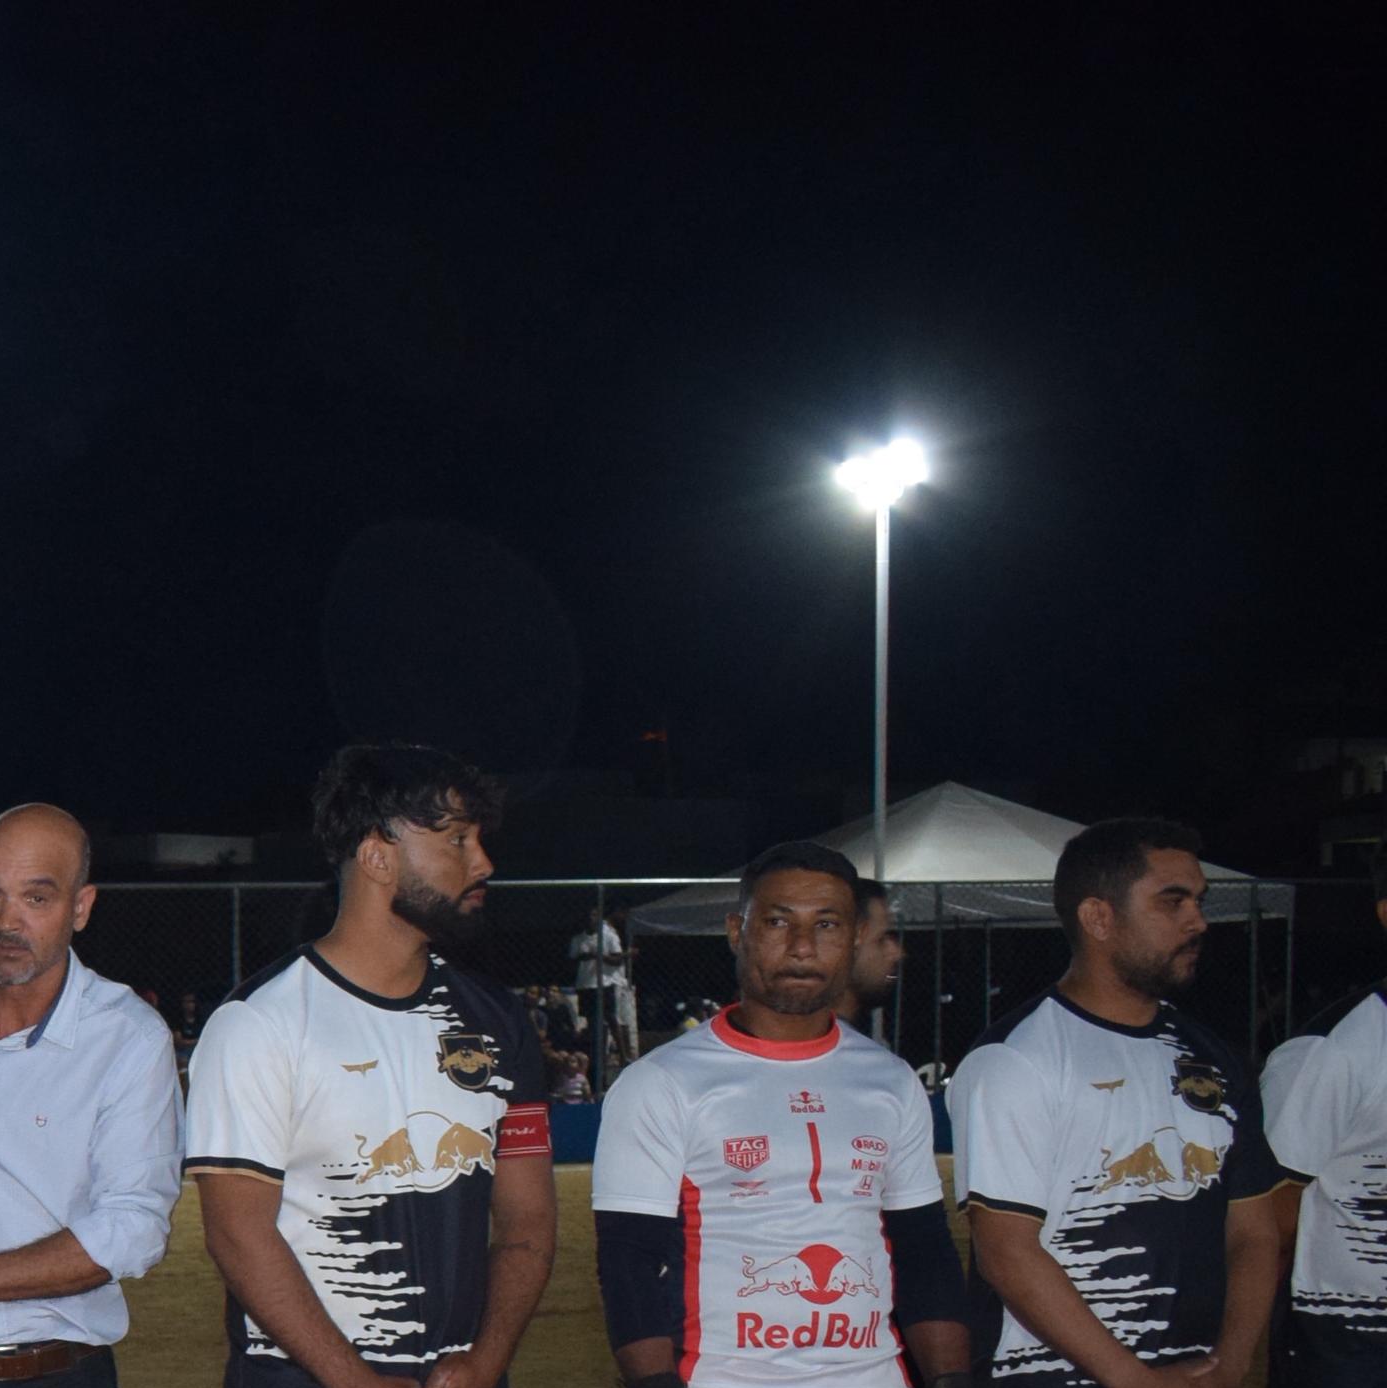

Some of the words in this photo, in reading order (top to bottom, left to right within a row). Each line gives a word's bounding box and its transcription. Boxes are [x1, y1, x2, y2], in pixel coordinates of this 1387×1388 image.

[728, 1139, 764, 1152] TAG
[726, 1151, 767, 1169] HEUER
[737, 1311, 820, 1349] Red
[822, 1311, 881, 1350] Bull
